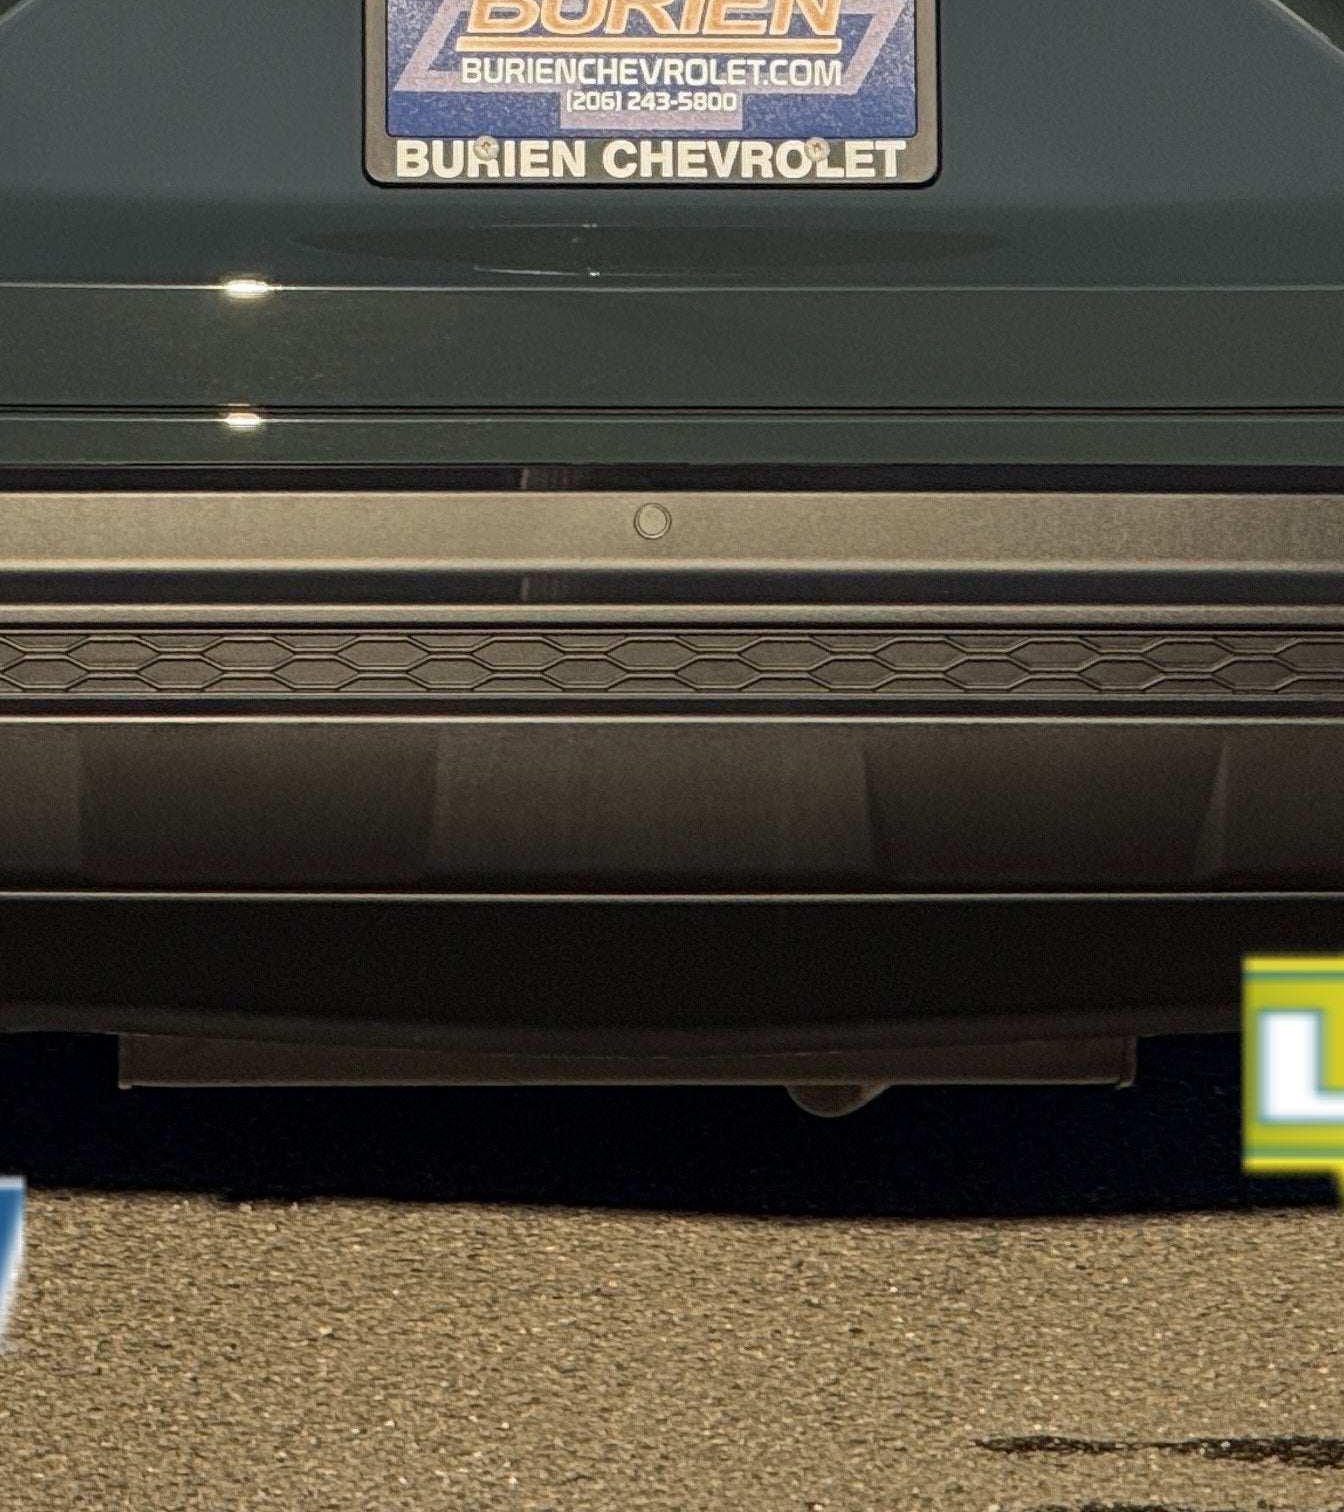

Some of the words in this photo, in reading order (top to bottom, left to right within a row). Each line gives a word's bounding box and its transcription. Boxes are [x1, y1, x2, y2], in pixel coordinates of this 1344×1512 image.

[460, 57, 842, 88] BURIENCHEVROLET.COM
[565, 92, 622, 113] (206)
[627, 91, 738, 112] 243-5800
[396, 141, 586, 178] BURIEN
[603, 140, 907, 179] CHEVROLET
